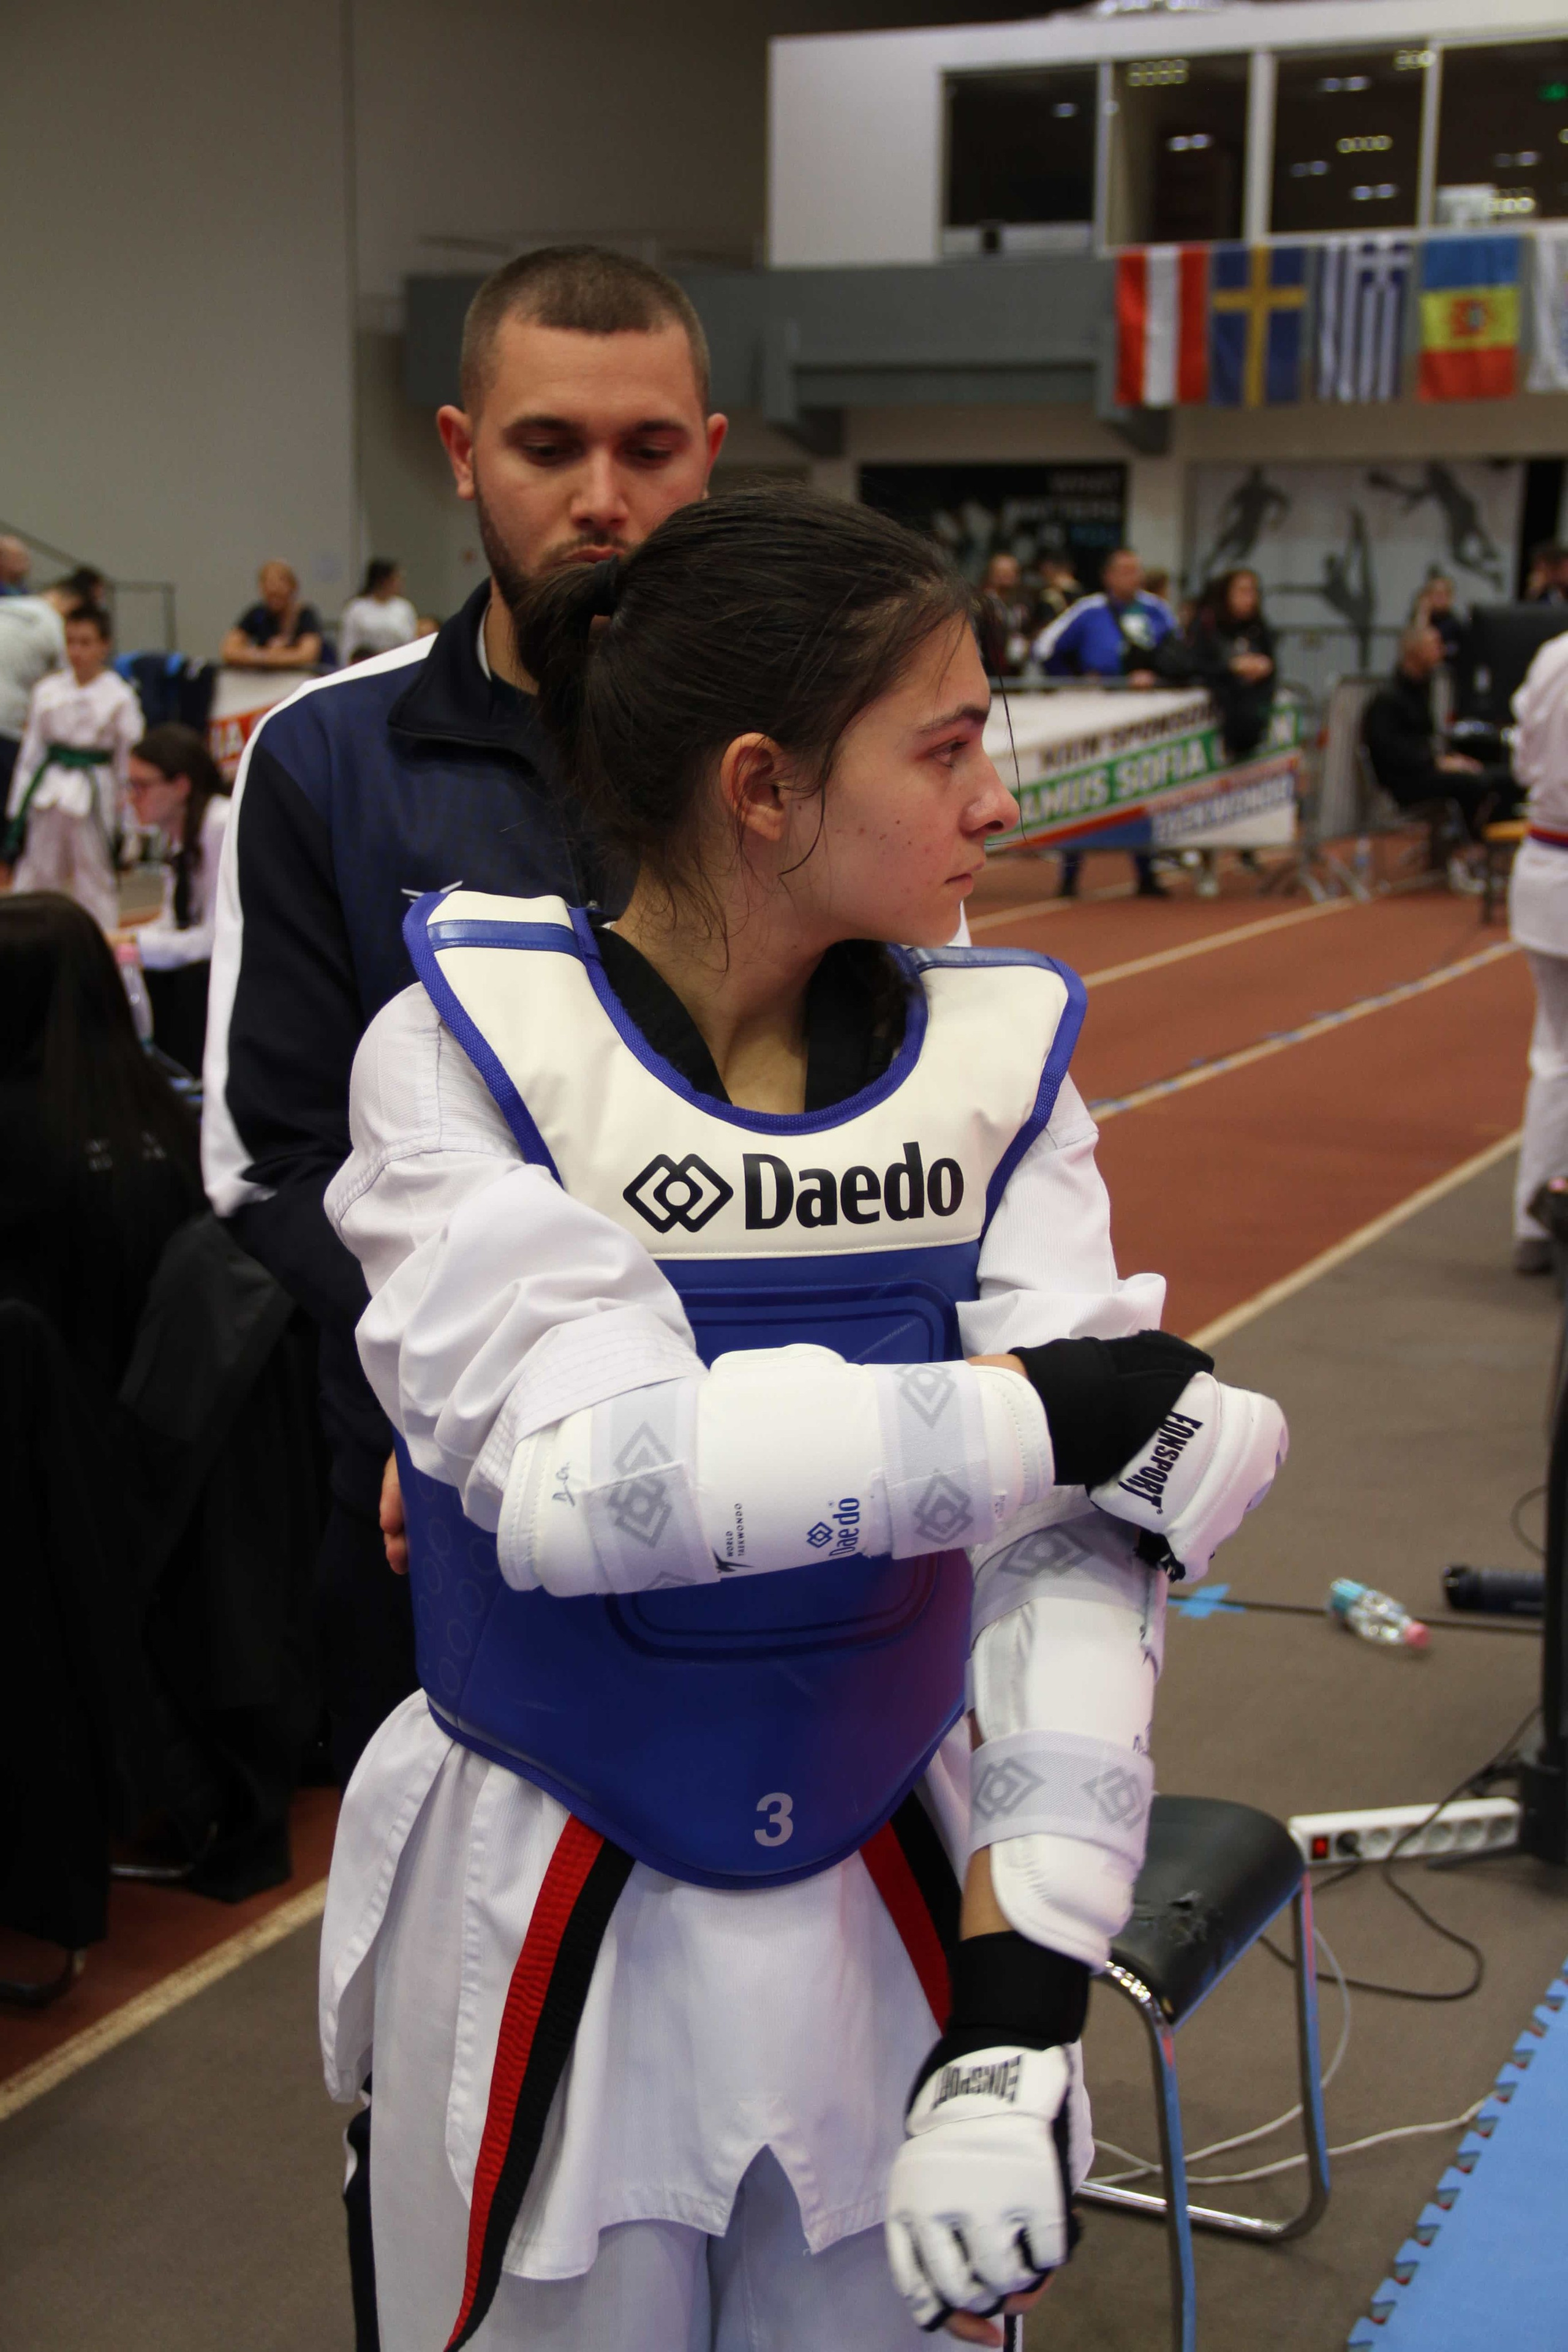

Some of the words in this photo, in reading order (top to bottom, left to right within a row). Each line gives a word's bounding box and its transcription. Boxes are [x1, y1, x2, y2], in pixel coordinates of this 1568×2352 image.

[1020, 769, 1107, 823] AMUS
[1116, 740, 1207, 797] SOFIA
[742, 1142, 964, 1230] Daedo
[1118, 1410, 1203, 1508] FONSPORT
[735, 1502, 745, 1556] TAEKWONDO
[829, 1498, 860, 1556] Daedo
[754, 1792, 794, 1847] 3
